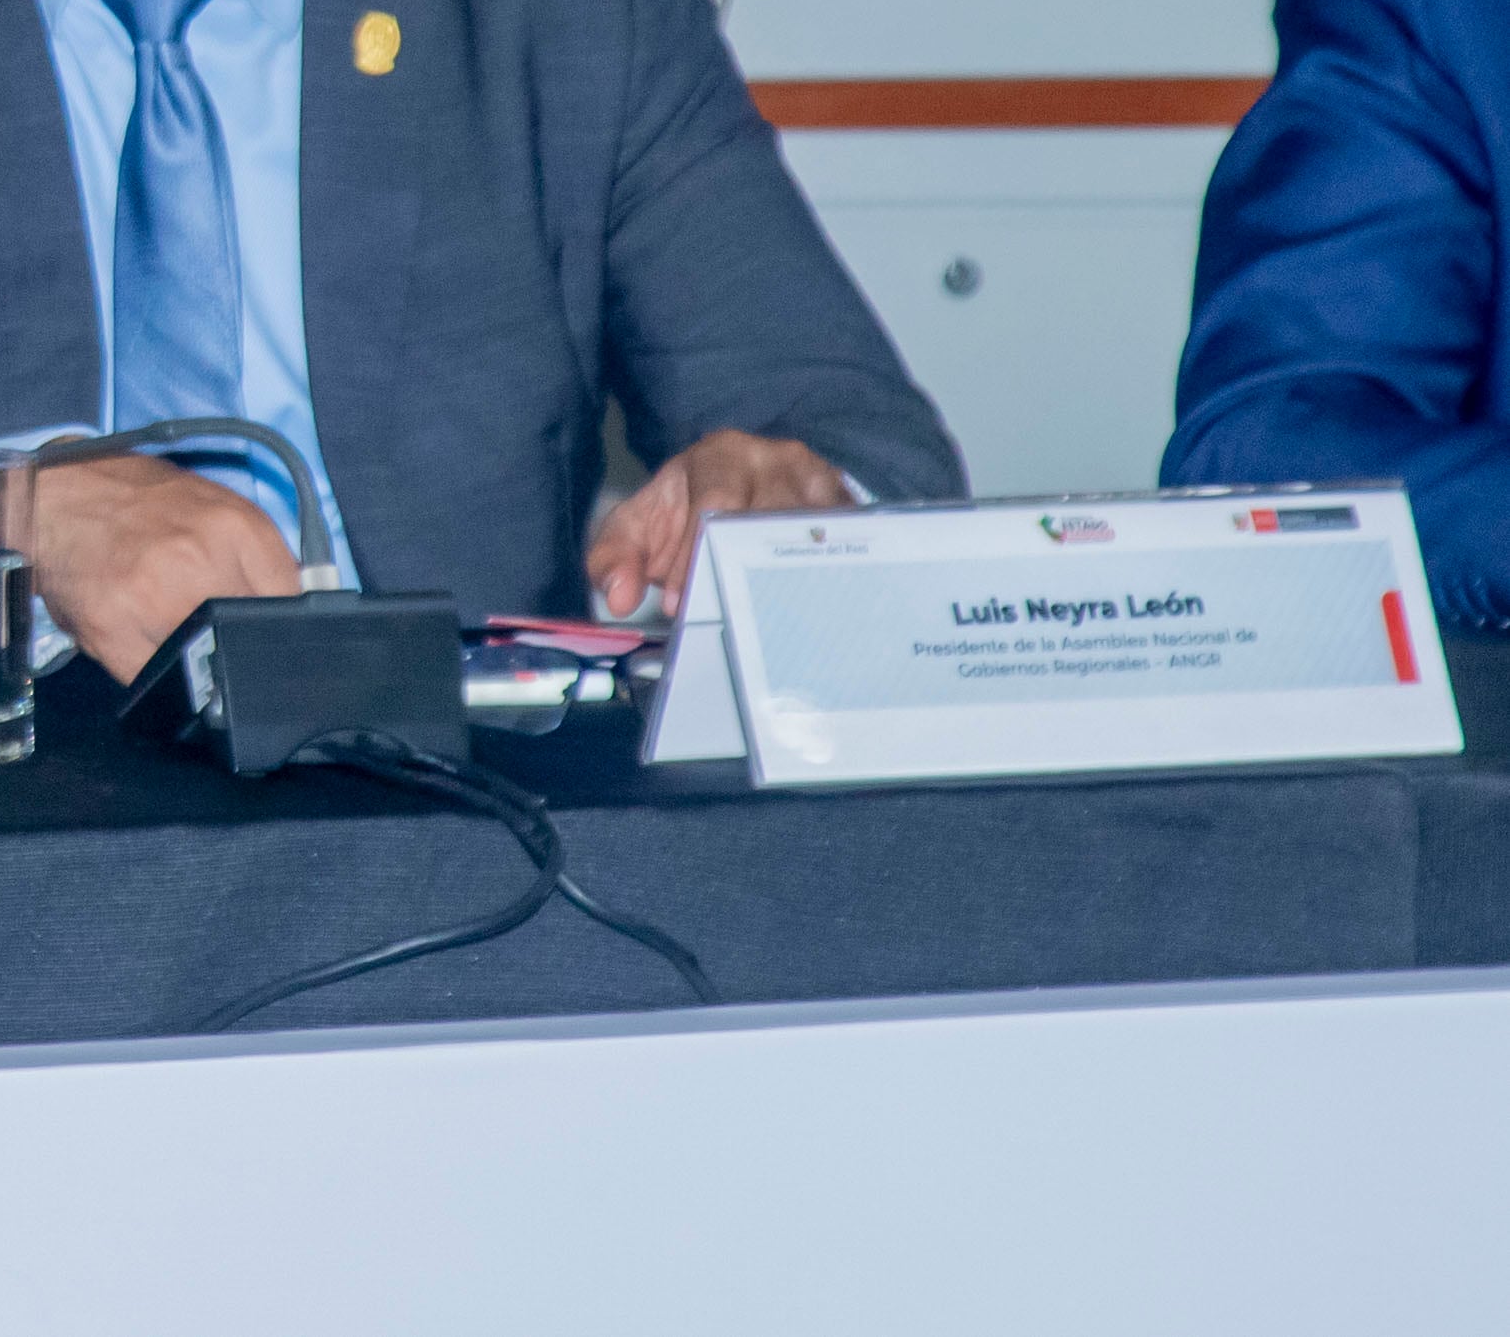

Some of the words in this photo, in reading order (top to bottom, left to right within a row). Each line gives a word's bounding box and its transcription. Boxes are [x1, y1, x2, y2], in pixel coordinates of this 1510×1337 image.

[952, 597, 1019, 626] Luis
[1026, 597, 1119, 627] Neyra
[1127, 590, 1205, 618] León
[913, 638, 1008, 656] Presidente
[1014, 637, 1036, 651] de
[1041, 636, 1056, 651] la
[1061, 633, 1147, 650] Asamblea
[1152, 629, 1230, 647] Nacional
[1235, 628, 1258, 643] de
[958, 662, 1048, 678] Gobiernos
[1053, 656, 1151, 677] Regionales
